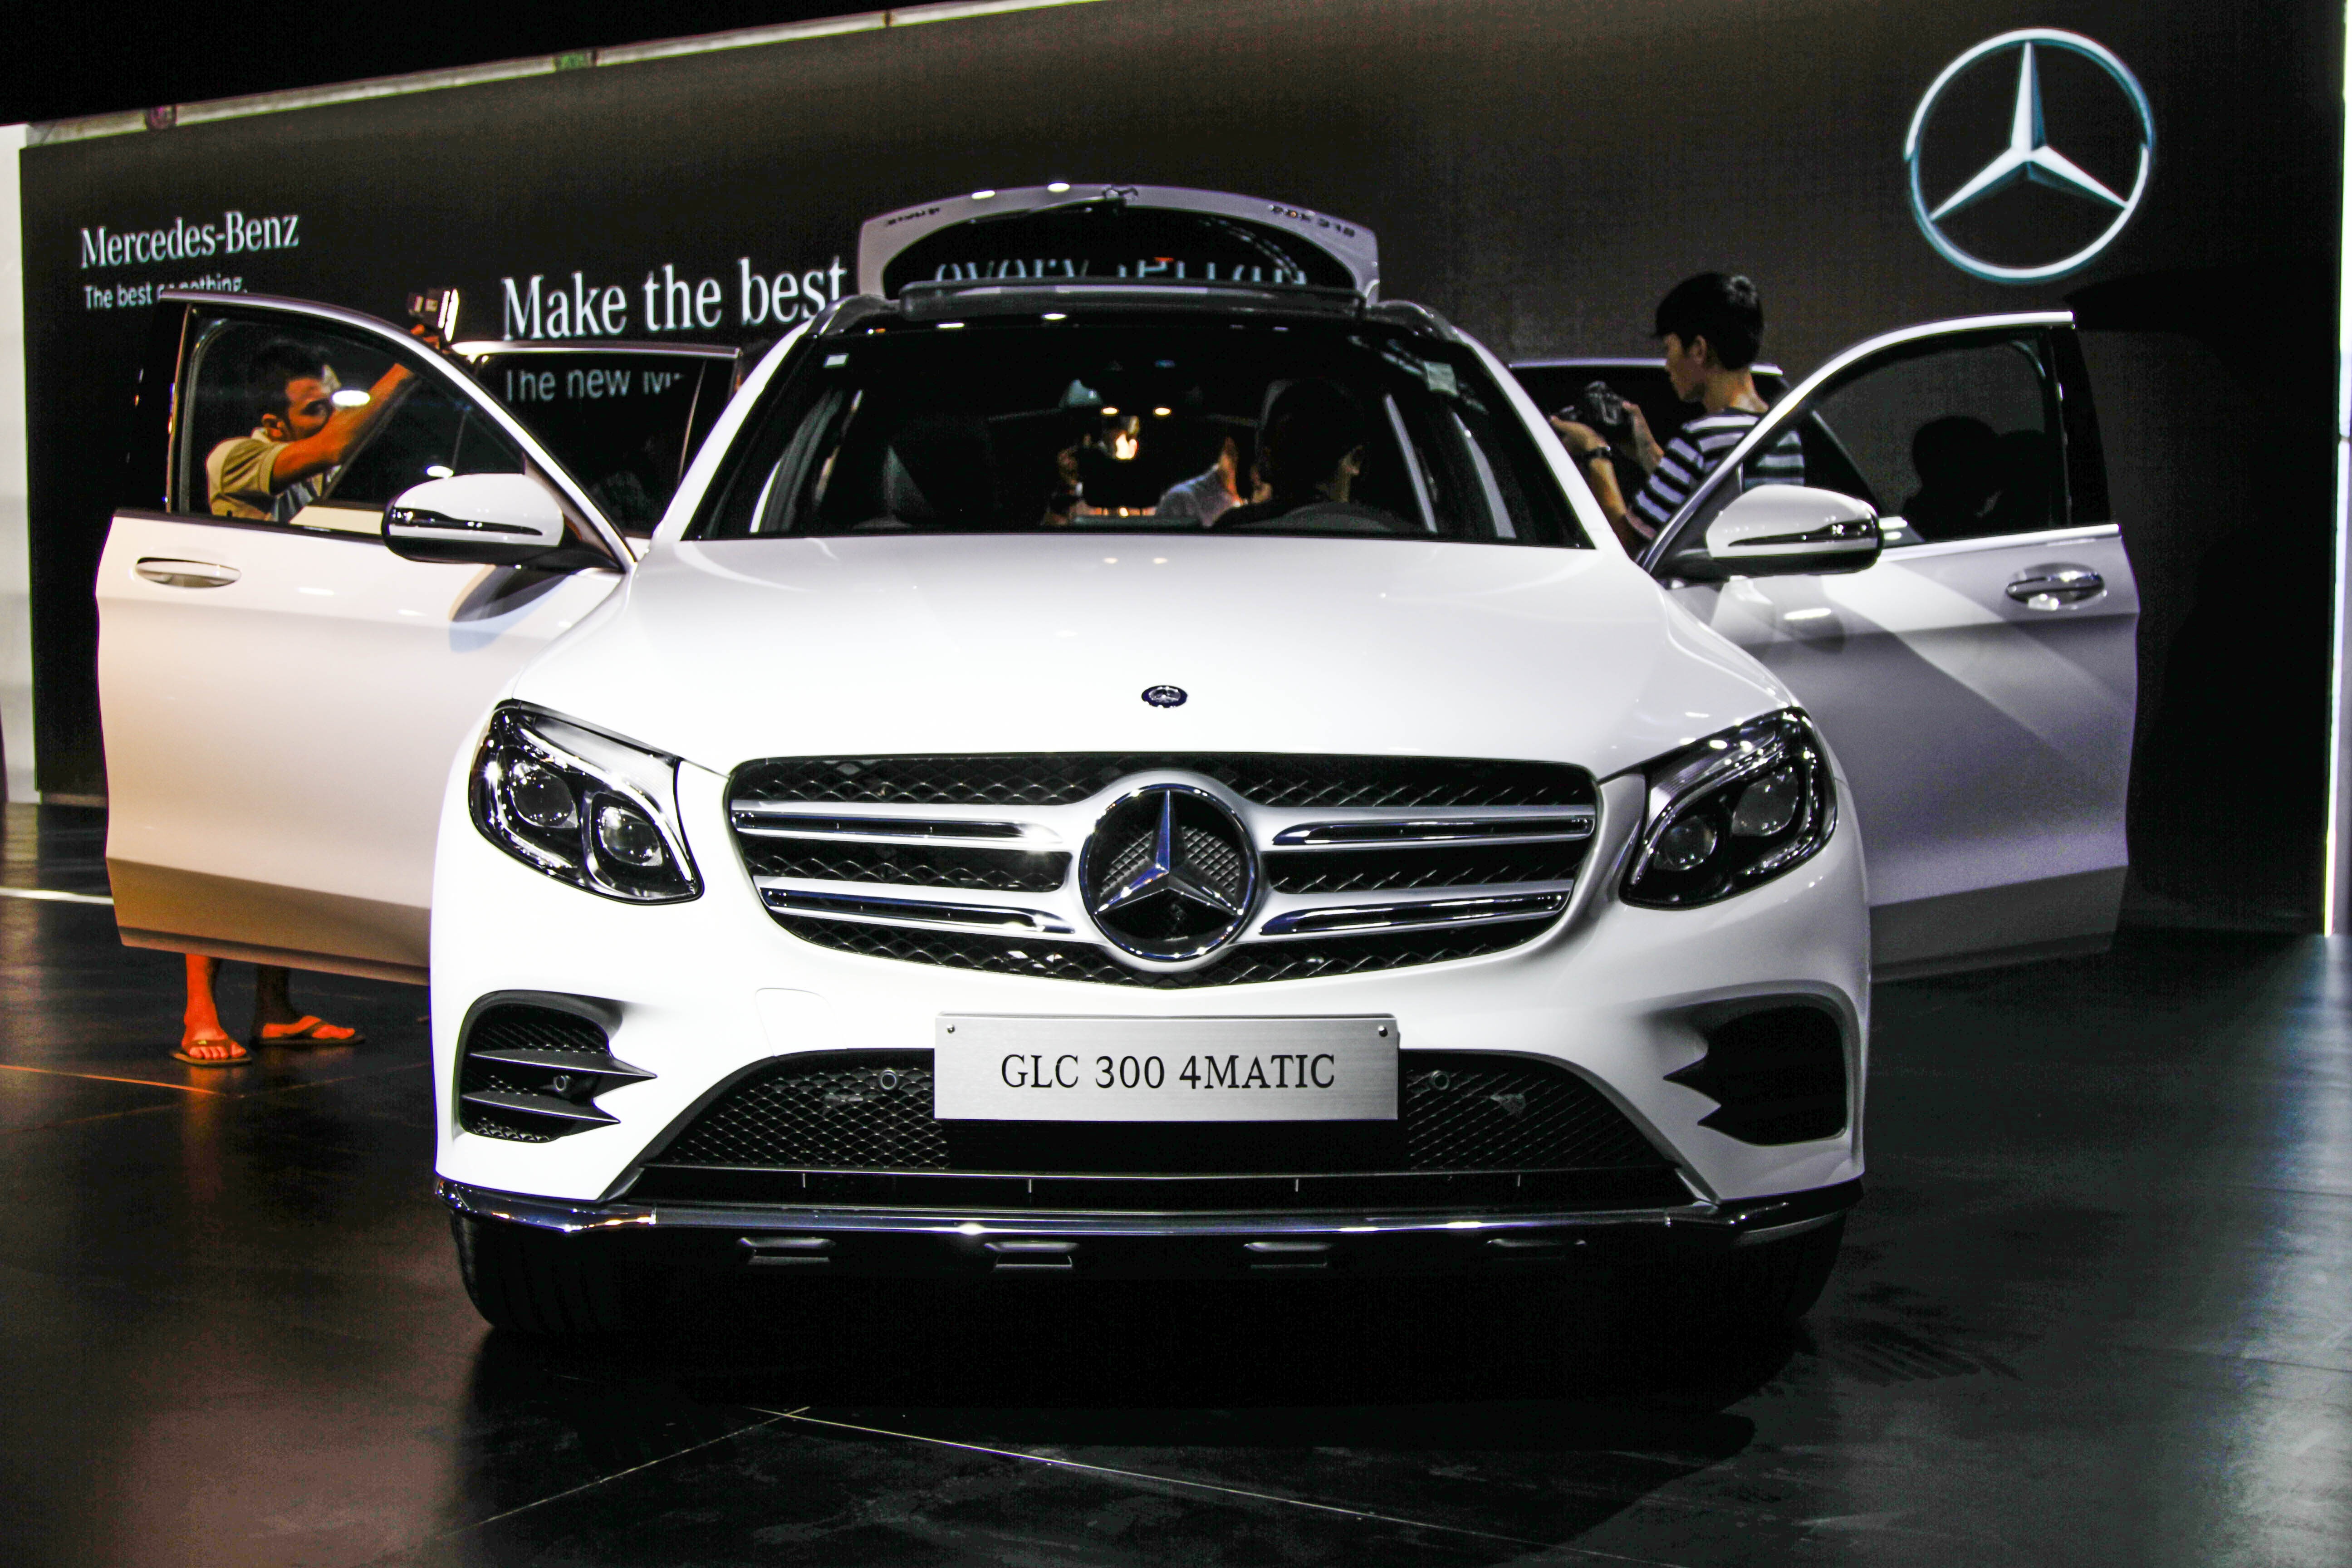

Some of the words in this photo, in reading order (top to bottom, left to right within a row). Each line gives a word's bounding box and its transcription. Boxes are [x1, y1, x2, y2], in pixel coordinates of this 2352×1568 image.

[80, 211, 299, 269] Mercedes-Benz
[83, 285, 113, 309] The
[117, 282, 152, 307] best
[501, 270, 627, 340] Make
[642, 263, 722, 332] the
[738, 255, 848, 326] best
[567, 369, 631, 398] new
[1001, 1054, 1078, 1089] GLC
[1095, 1055, 1165, 1089] 300
[1179, 1053, 1335, 1090] 4MATIC
